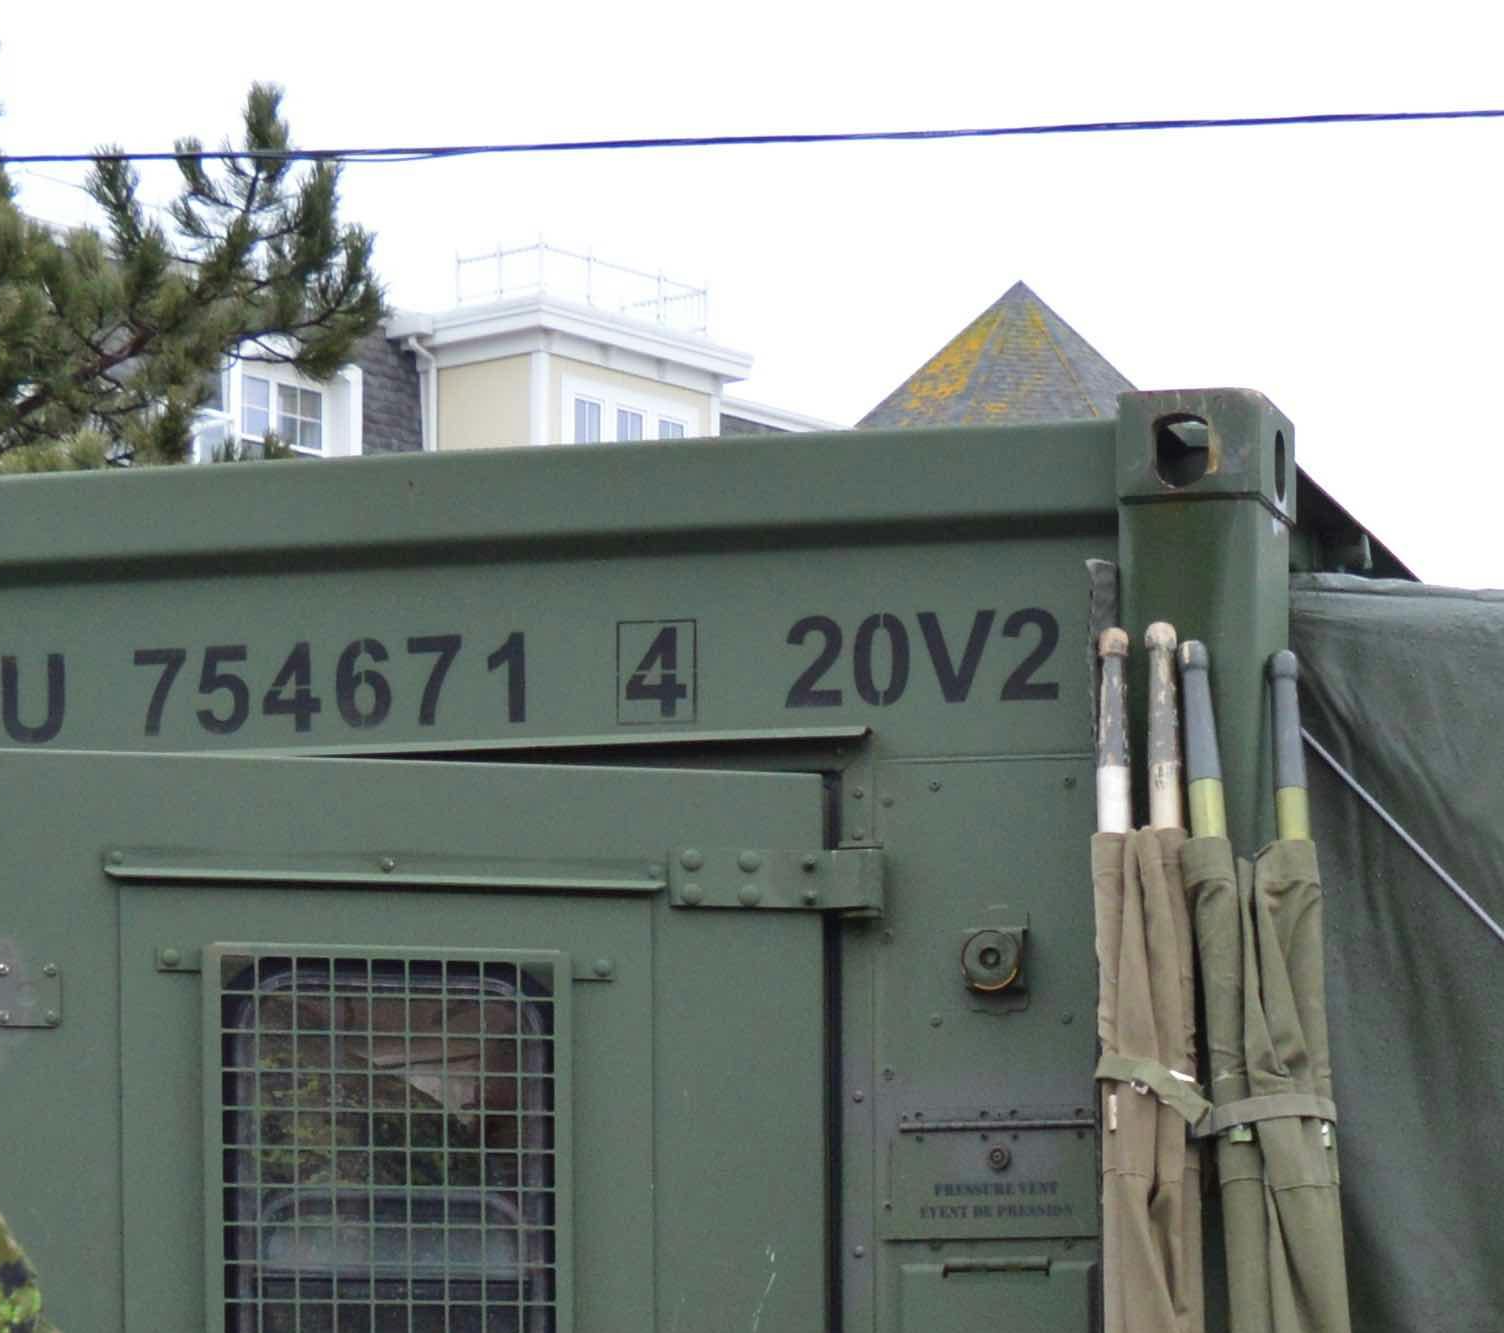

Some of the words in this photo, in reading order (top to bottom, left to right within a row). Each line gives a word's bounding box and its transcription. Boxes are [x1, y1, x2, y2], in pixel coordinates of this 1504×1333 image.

[133, 632, 527, 737] 754671
[625, 627, 688, 719] 4
[785, 607, 1060, 708] 20V2
[933, 1182, 1015, 1197] PRESSURE
[1017, 1181, 1059, 1196] VENT
[973, 1204, 993, 1218] DE
[998, 1202, 1074, 1217] PRESSION
